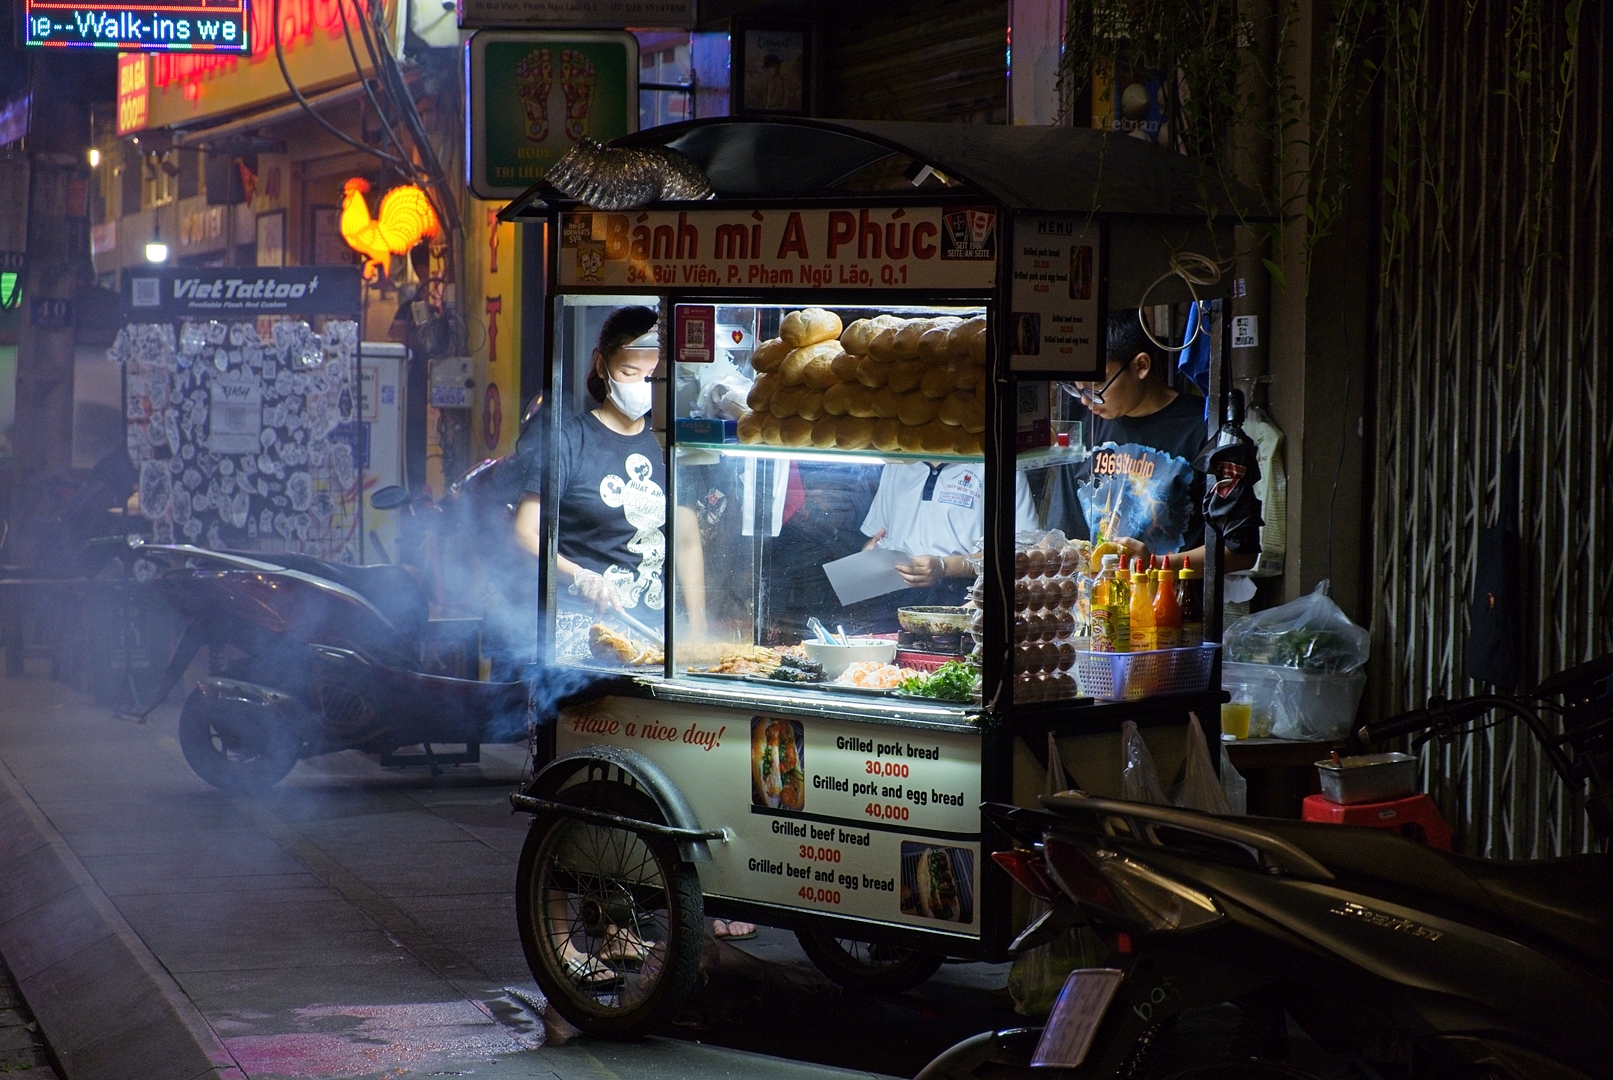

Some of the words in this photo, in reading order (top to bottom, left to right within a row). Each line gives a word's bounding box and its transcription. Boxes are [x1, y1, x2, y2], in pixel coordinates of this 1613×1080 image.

[517, 147, 551, 159] BODY
[605, 212, 699, 260] Bánh
[714, 210, 764, 260] mì
[777, 211, 809, 259] A
[827, 207, 938, 260] Phúc
[1038, 221, 1073, 233] MENU
[947, 249, 963, 257] SEITE
[964, 249, 973, 257] AN
[974, 249, 990, 258] SEITE
[955, 241, 969, 250] SEIT
[627, 264, 647, 283] 34
[653, 264, 676, 284] Bùi
[682, 264, 721, 287] Viện,
[727, 264, 742, 284] P.
[748, 264, 794, 287] Phạm
[800, 264, 833, 288] Ngũ
[839, 264, 874, 287] Lão,
[880, 264, 907, 286] Q.1
[244, 301, 259, 309] And
[629, 481, 648, 492] HUAT
[573, 714, 620, 735] Have
[625, 722, 637, 737] a
[640, 720, 678, 742] nice
[682, 723, 726, 751] day!
[836, 736, 873, 753] Grilled
[877, 742, 903, 757] pork
[906, 743, 939, 760] bread
[865, 760, 909, 778] 30,000
[813, 775, 848, 792] Grilled
[852, 781, 877, 797] pork
[882, 785, 902, 799] and
[906, 789, 927, 806] egg
[931, 789, 964, 806] bread
[865, 803, 909, 821] 40,000
[772, 820, 807, 837] Grilled
[810, 825, 835, 841] beef
[838, 829, 870, 846] bread
[799, 844, 841, 863] 30,000
[748, 858, 783, 876] Grilled
[786, 863, 811, 879] beef
[814, 870, 834, 883] and
[838, 874, 858, 890] egg
[862, 874, 894, 892] bread
[798, 886, 841, 905] 40,000
